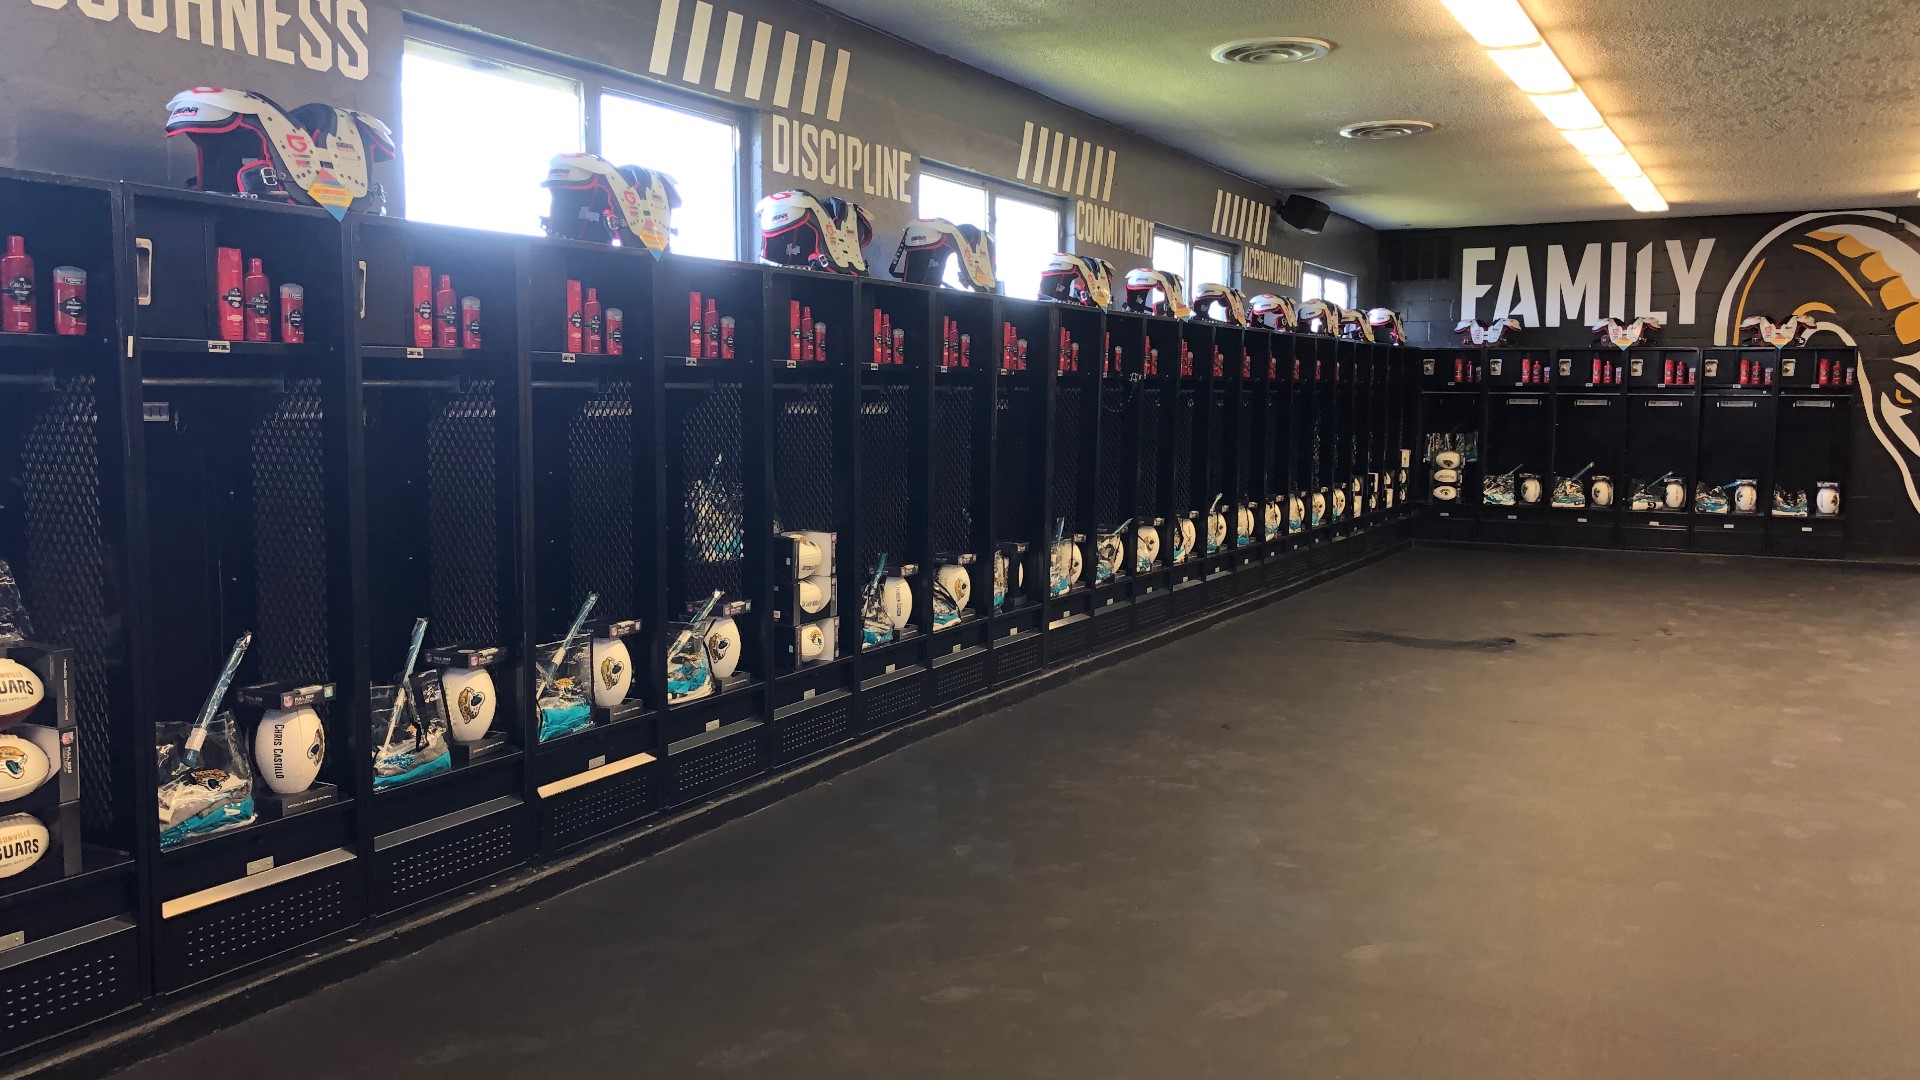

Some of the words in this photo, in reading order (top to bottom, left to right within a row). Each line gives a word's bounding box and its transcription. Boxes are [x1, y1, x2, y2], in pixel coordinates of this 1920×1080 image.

[772, 113, 912, 203] DISCIPLINE
[1075, 199, 1155, 258] COMMITMENT
[1242, 245, 1304, 289] ACCOUNTABILITY
[1460, 237, 1716, 328] FAMILY
[273, 724, 285, 746] CHRIS
[273, 748, 285, 779] CASTILLO
